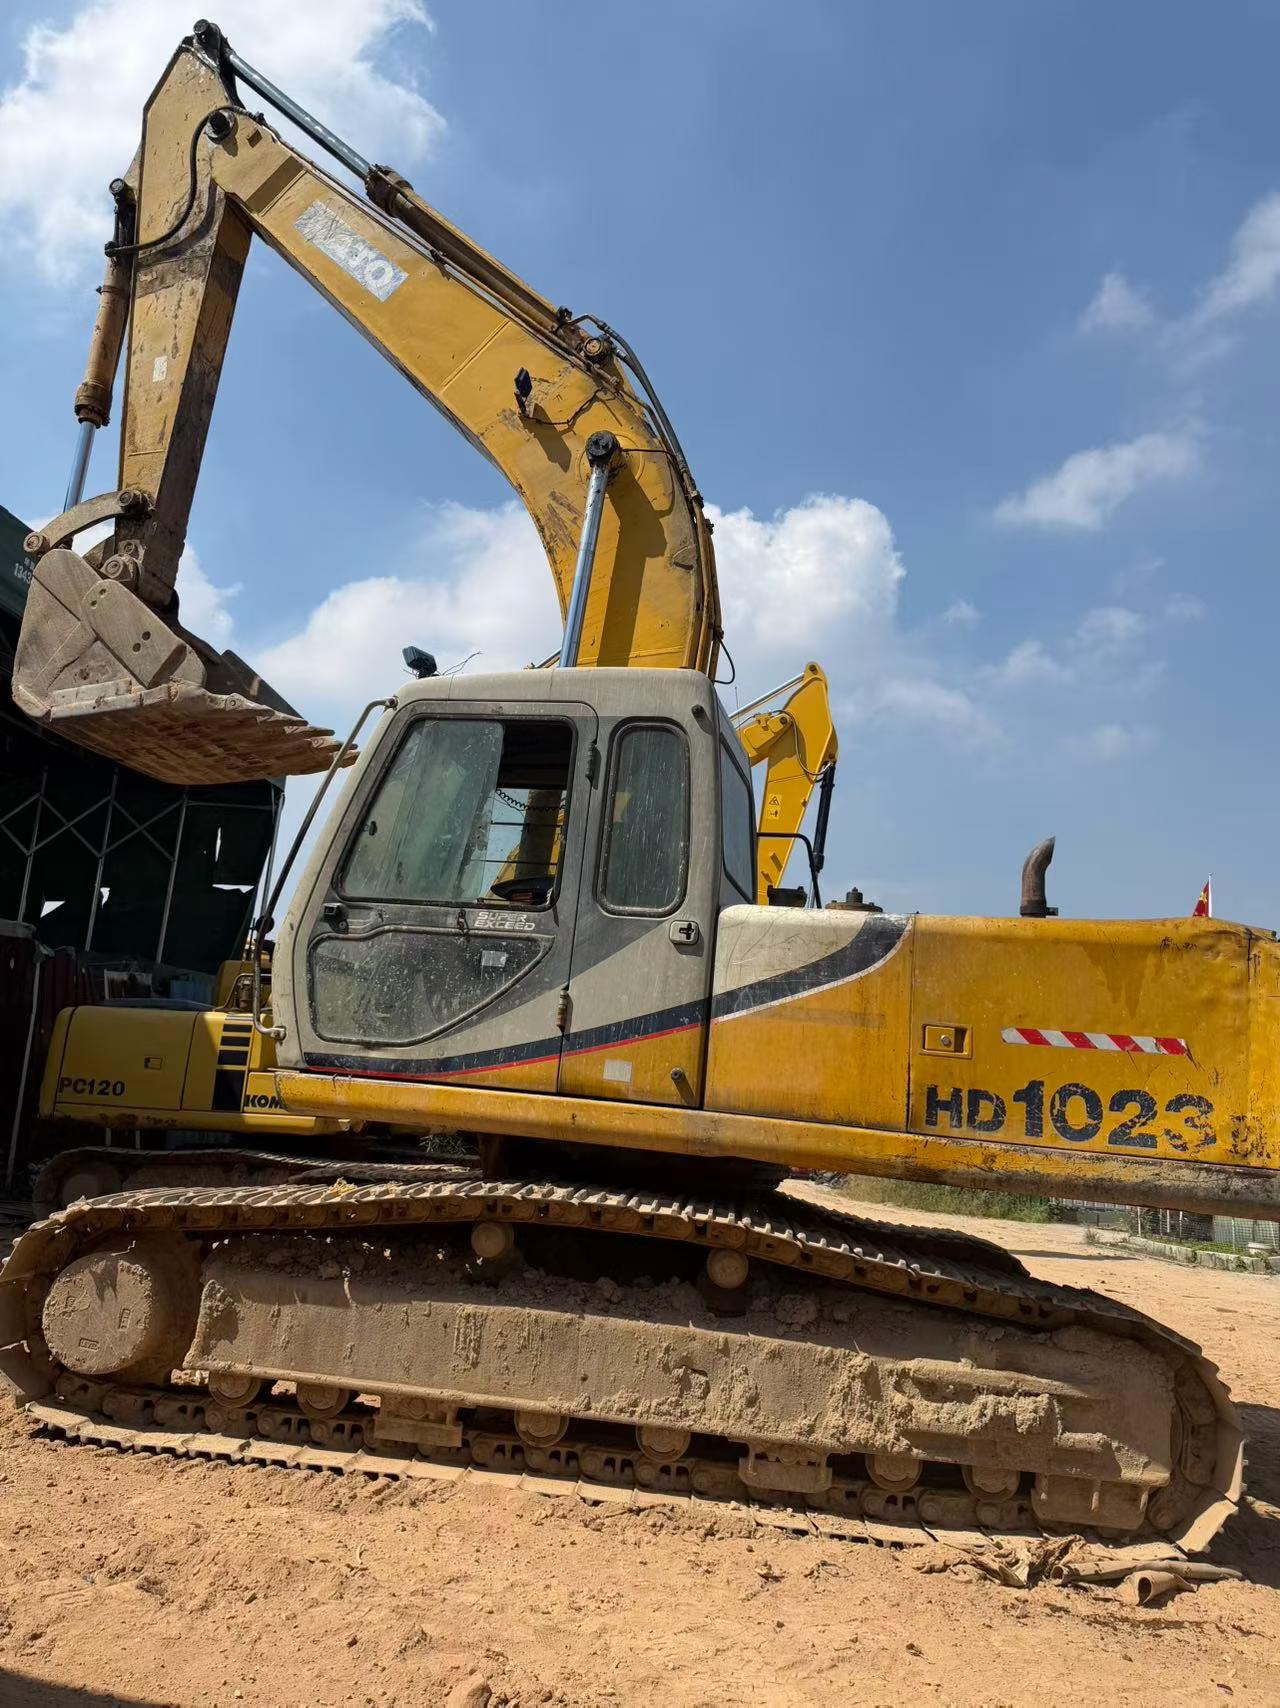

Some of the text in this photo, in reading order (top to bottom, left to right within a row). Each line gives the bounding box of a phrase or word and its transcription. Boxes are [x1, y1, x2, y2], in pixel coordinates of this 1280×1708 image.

[474, 919, 535, 931] EXCEED
[477, 911, 527, 923] SUPER
[58, 1076, 126, 1097] PC120
[925, 1079, 1217, 1152] HD1023
